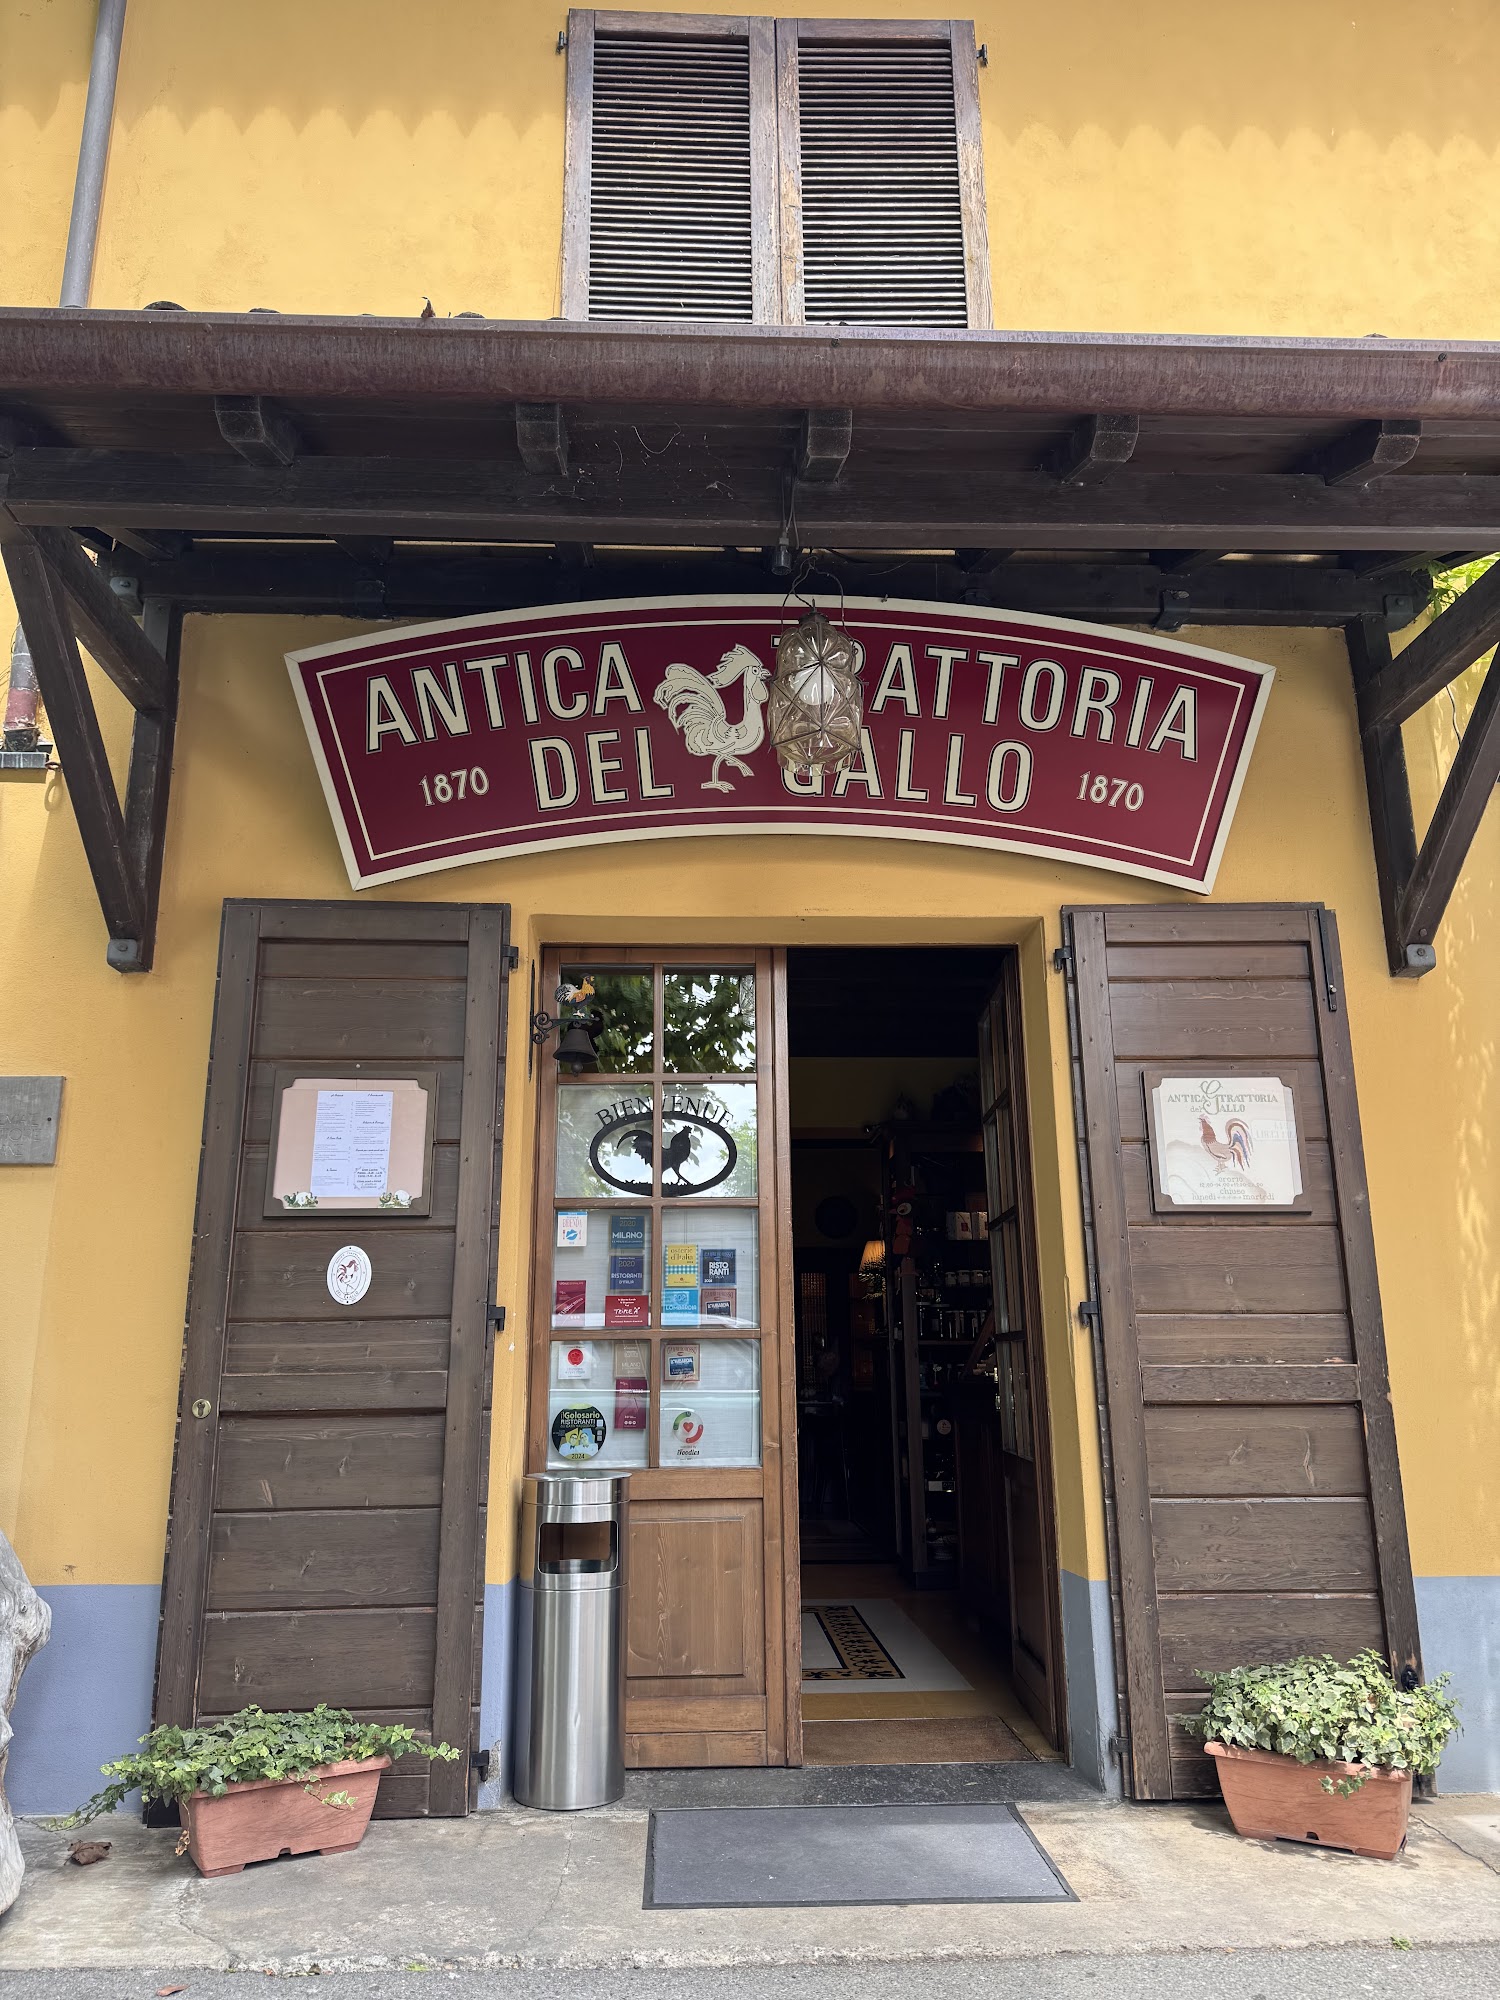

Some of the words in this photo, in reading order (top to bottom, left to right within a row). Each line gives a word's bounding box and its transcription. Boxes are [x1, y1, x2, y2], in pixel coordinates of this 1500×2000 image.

[366, 643, 644, 754] ANTICA
[420, 766, 489, 807] 1870
[530, 729, 676, 814] DEL
[1076, 770, 1145, 812] 1870
[595, 1095, 734, 1130] BIENENUE
[1168, 1094, 1206, 1103] ANTICA
[1219, 1094, 1278, 1103] TRATTORIA
[612, 1231, 643, 1239] MILANO
[709, 1261, 729, 1269] RISTO
[709, 1268, 729, 1276] RANTI
